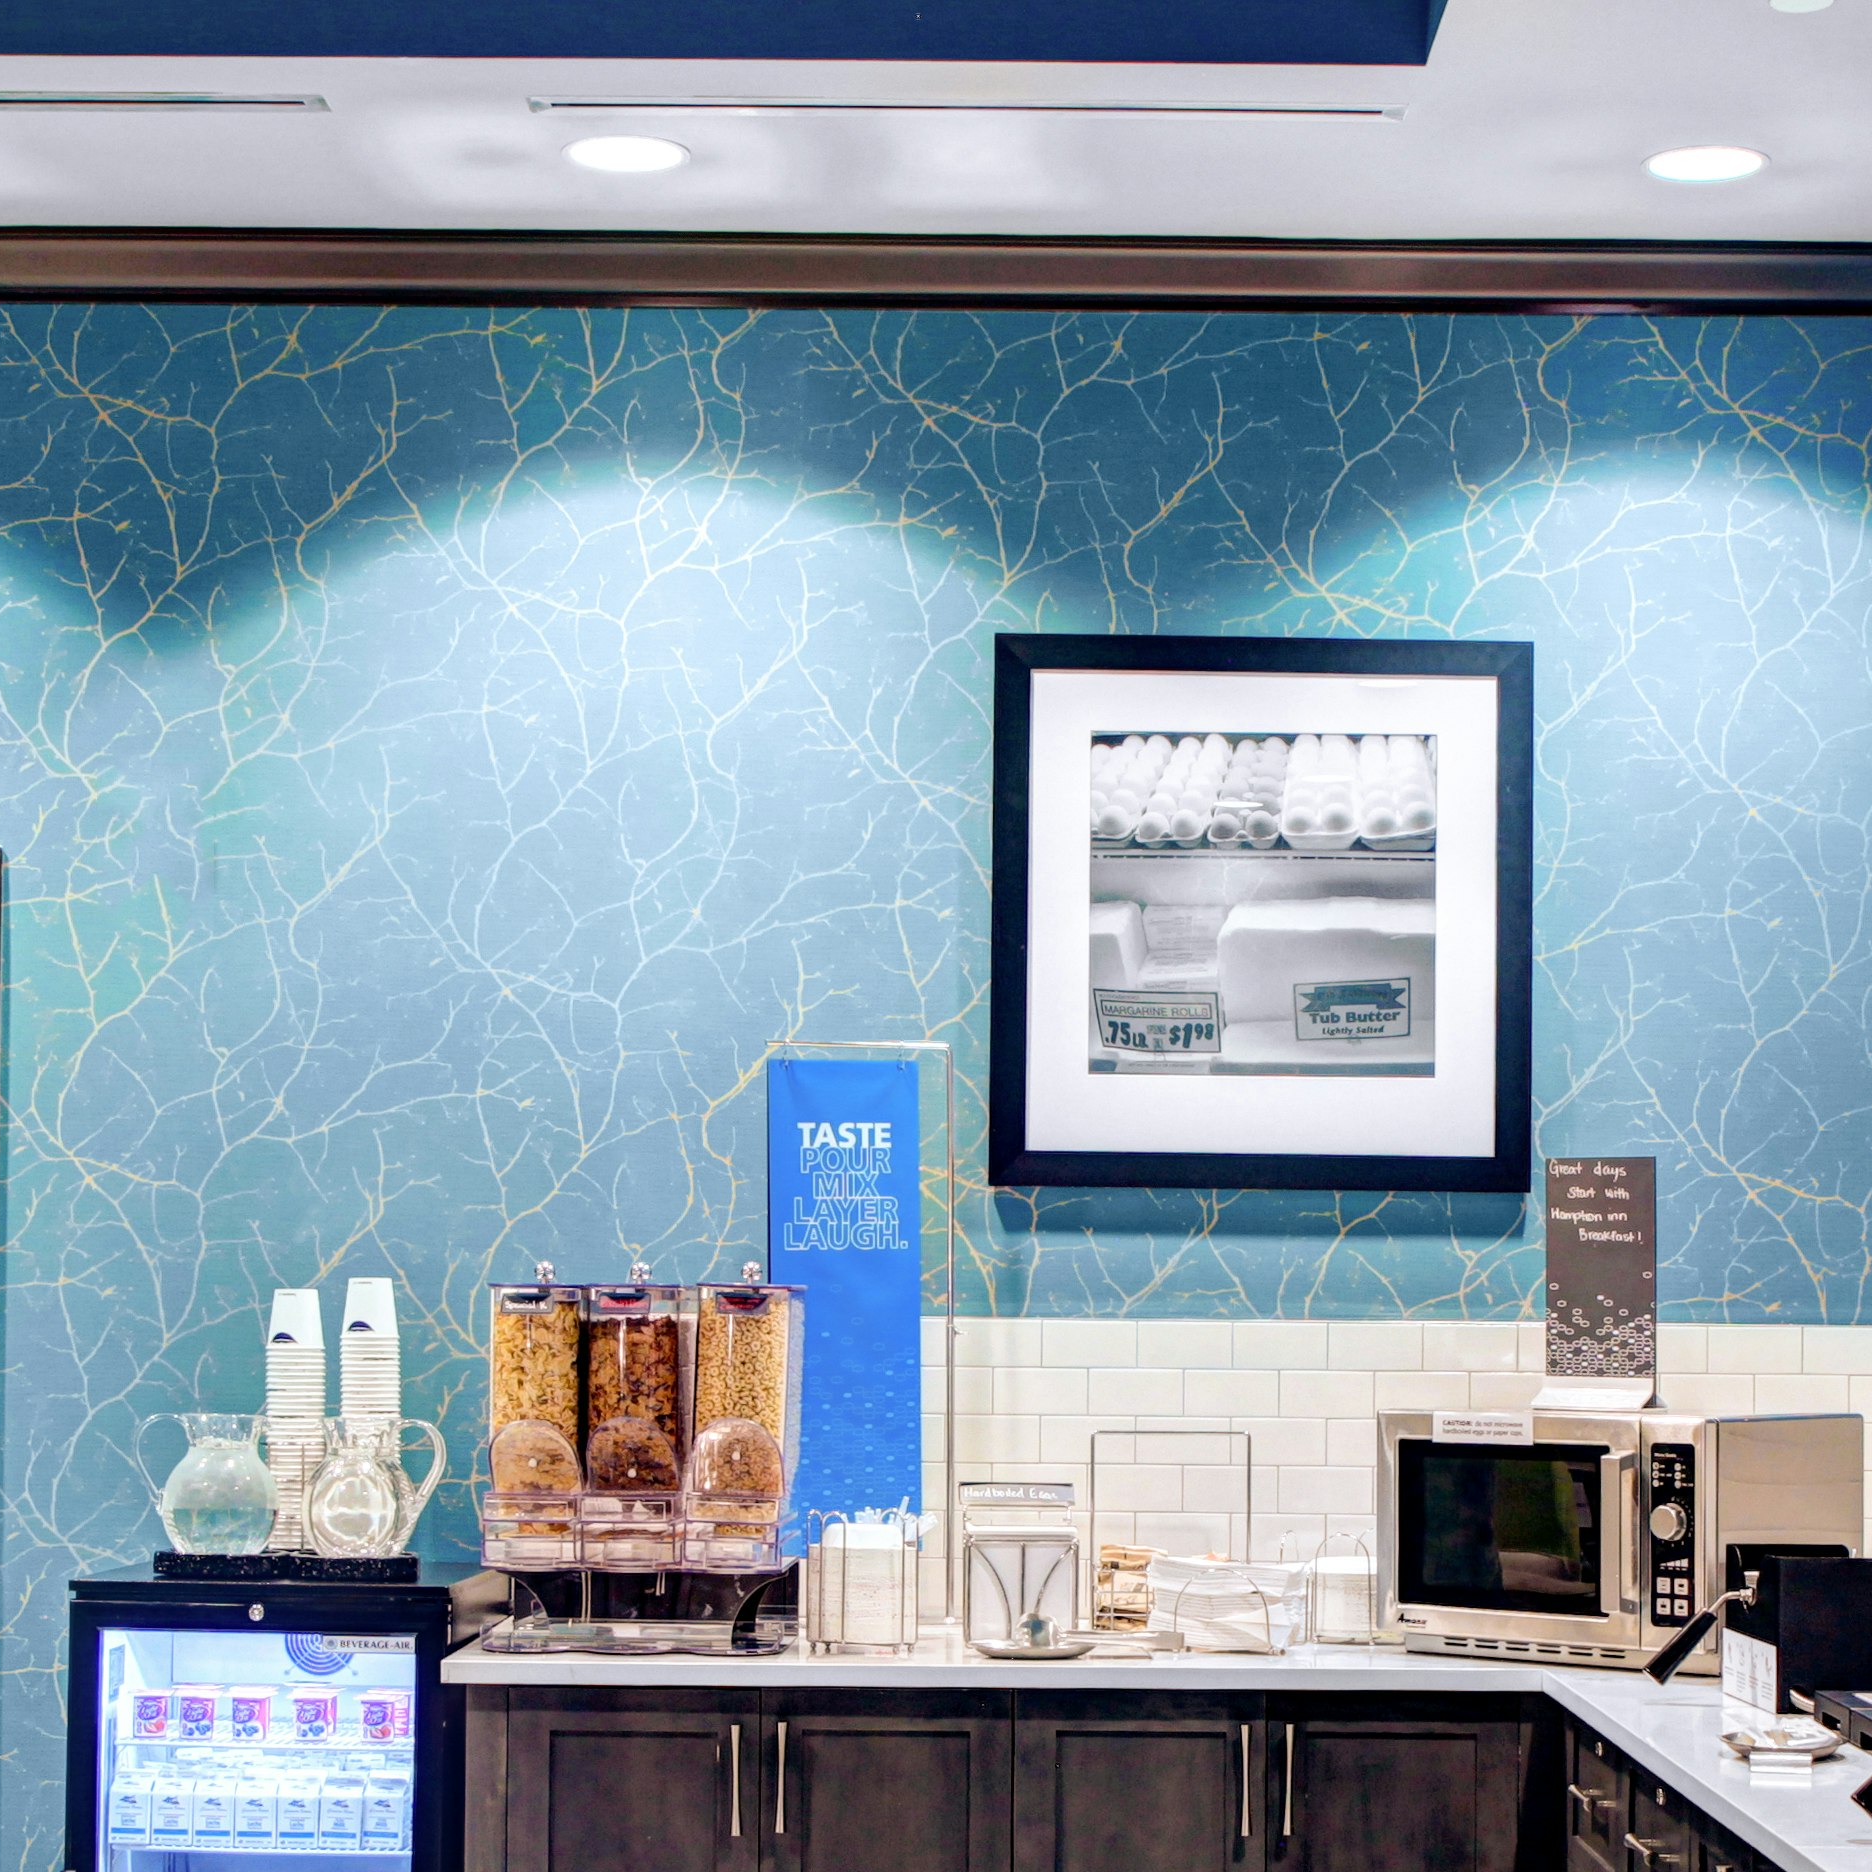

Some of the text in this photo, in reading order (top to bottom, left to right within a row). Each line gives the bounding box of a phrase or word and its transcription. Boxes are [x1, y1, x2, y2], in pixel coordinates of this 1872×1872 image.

[1104, 1005, 1208, 1017] MARGARINE ROLLS
[1309, 1011, 1401, 1024] Tub Butter
[1322, 1025, 1384, 1036] Lightly Salted
[798, 1122, 891, 1148] TASTE
[800, 1146, 891, 1173] POUR
[1549, 1159, 1627, 1182] Great days
[813, 1172, 879, 1199] MIX
[794, 1197, 898, 1224] LAYER
[1551, 1208, 1602, 1224] Hampton
[784, 1223, 909, 1250] LAUGH.
